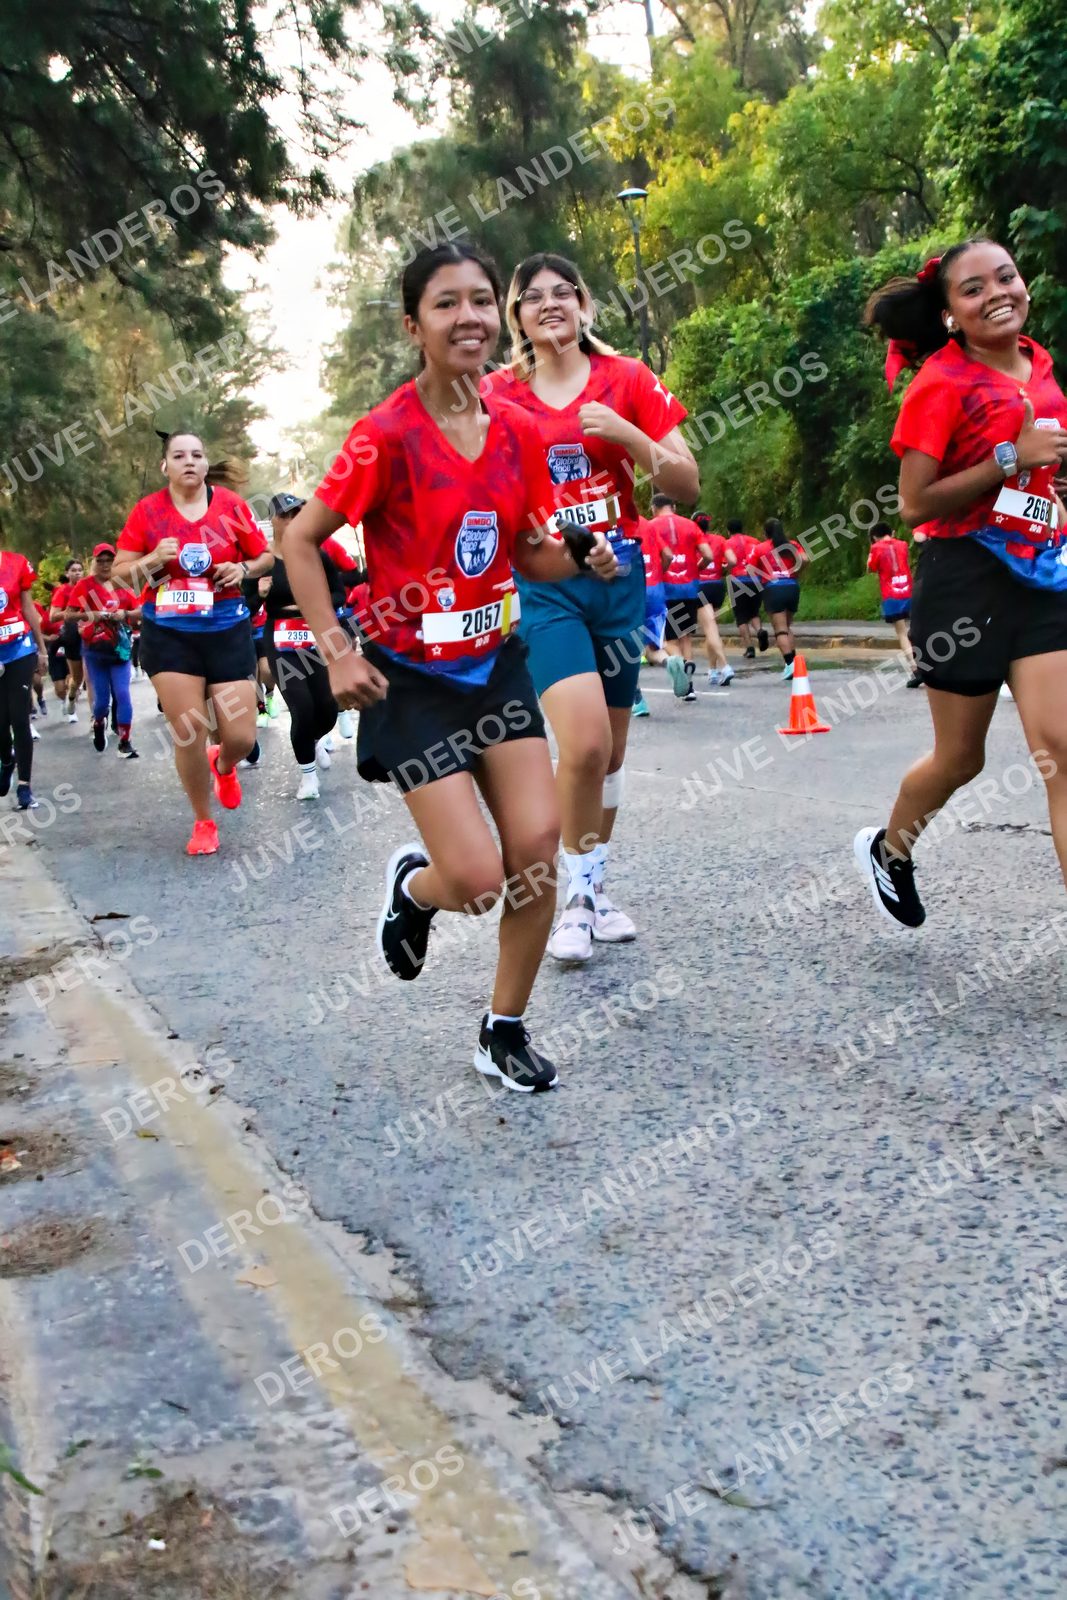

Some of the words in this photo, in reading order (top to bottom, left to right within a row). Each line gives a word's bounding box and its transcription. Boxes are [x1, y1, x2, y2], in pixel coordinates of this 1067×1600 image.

[467, 517, 491, 526] BIMBO
[172, 591, 195, 603] 1203
[462, 602, 501, 638] 2057
[287, 631, 308, 640] 2359
